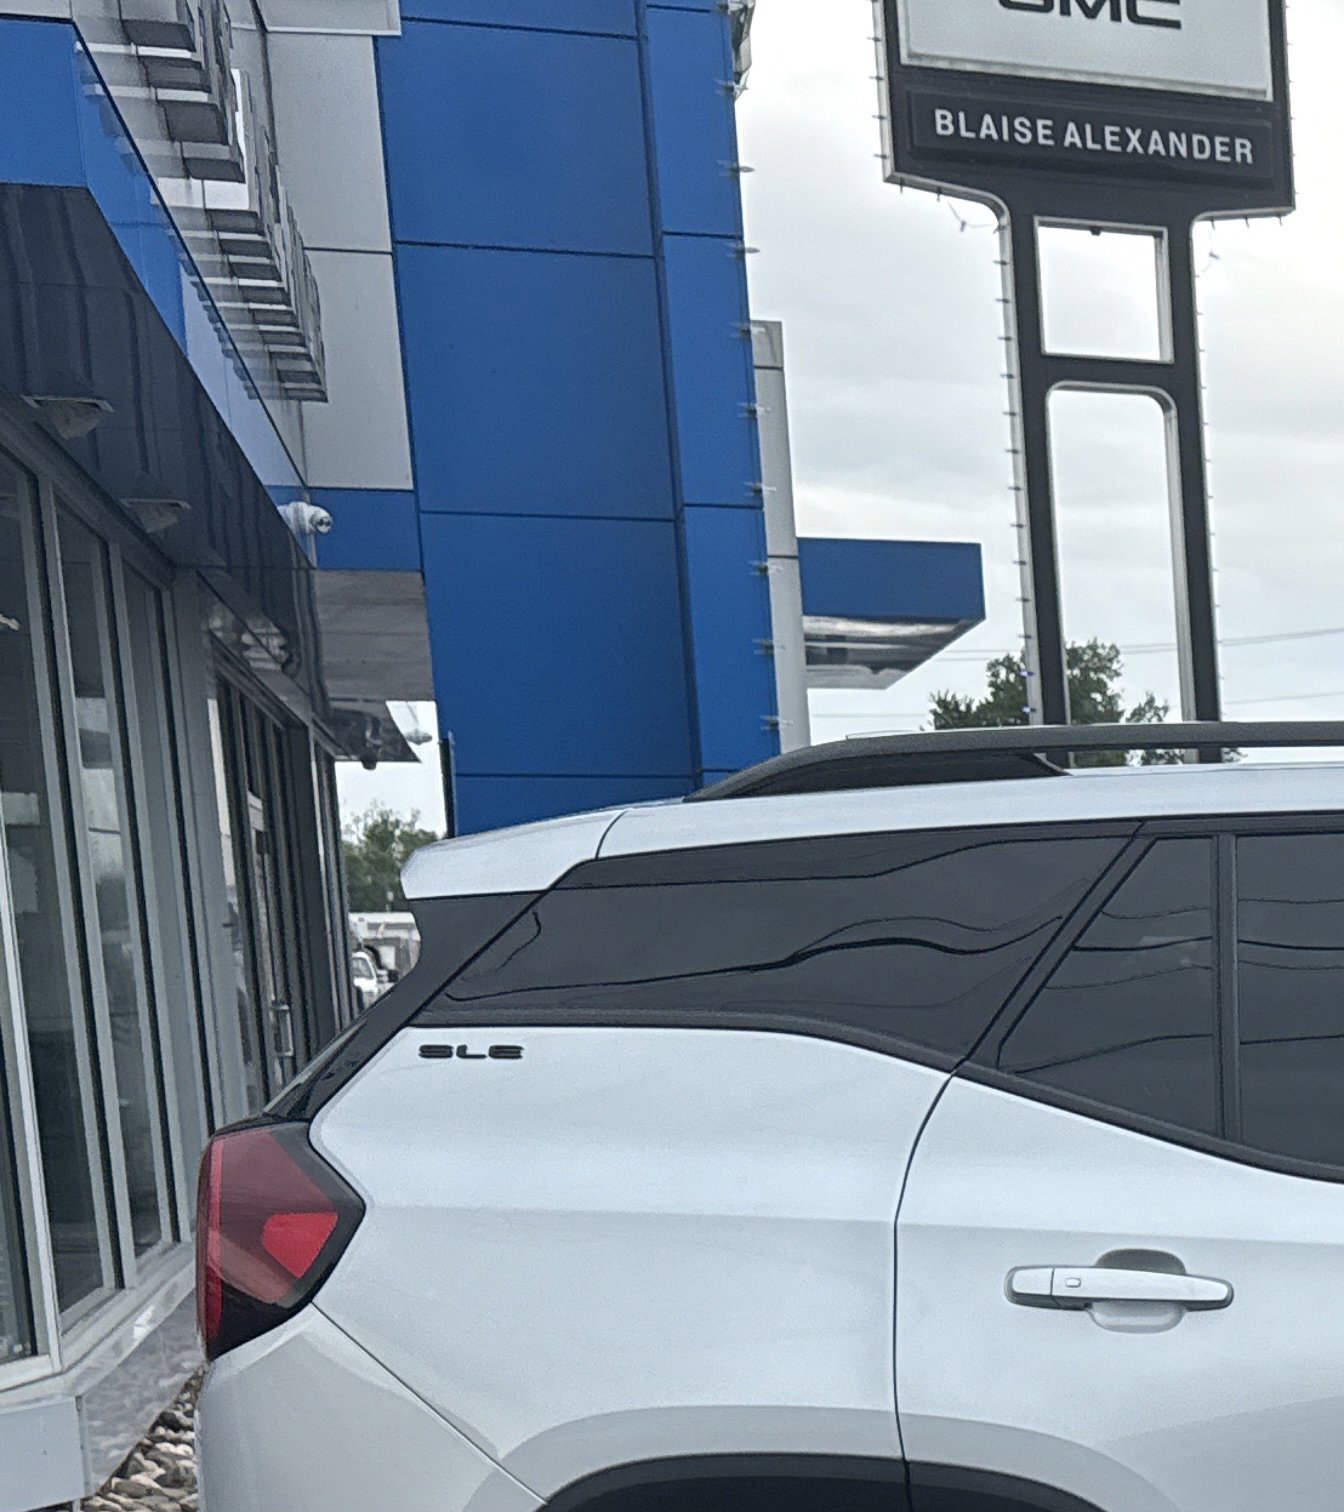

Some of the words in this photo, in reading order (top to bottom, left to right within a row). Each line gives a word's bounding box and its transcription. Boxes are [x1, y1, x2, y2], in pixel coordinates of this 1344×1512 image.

[934, 108, 1055, 146] BLAISE
[1063, 121, 1254, 164] ALEXANDER
[418, 1044, 524, 1060] SLE
